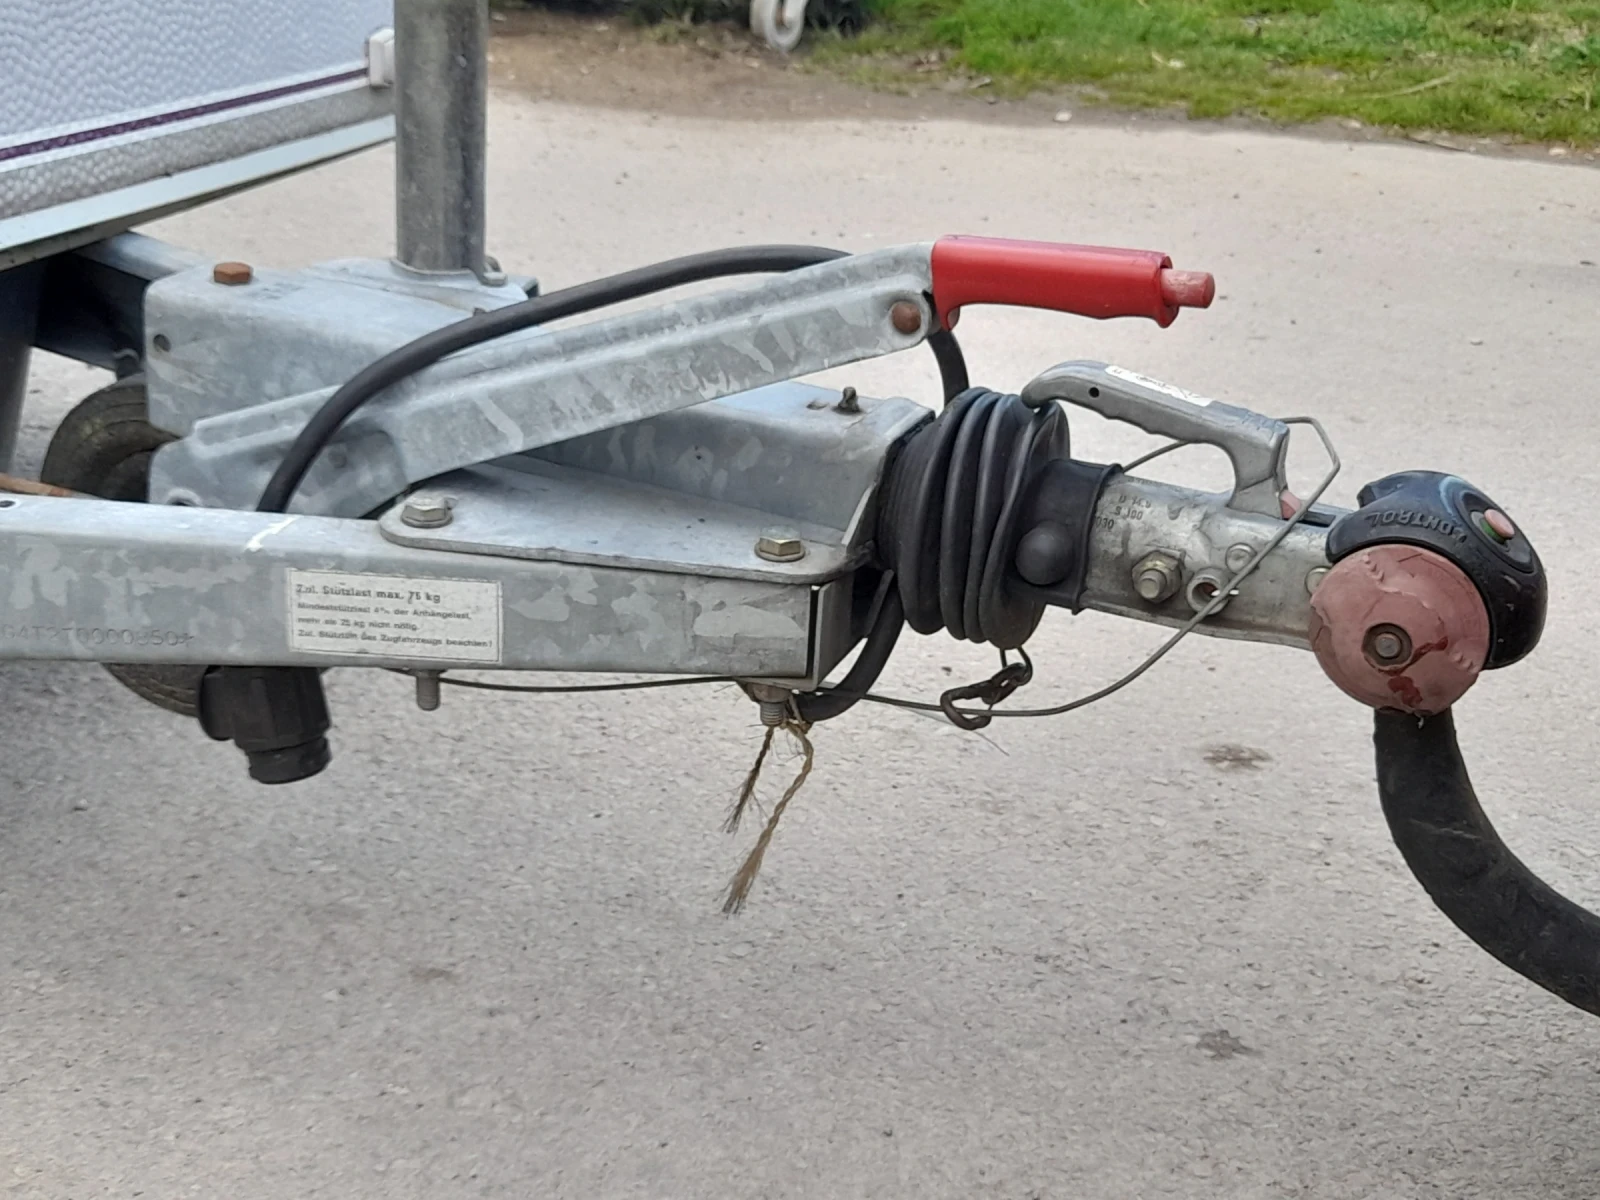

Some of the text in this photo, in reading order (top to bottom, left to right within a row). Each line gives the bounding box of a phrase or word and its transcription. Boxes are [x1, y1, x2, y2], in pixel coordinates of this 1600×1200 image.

[1364, 508, 1468, 544] CONTROL
[322, 585, 372, 598] Stützlast
[376, 590, 404, 600] max.
[407, 590, 421, 601] 75
[425, 592, 441, 604] kg
[393, 608, 409, 616] der
